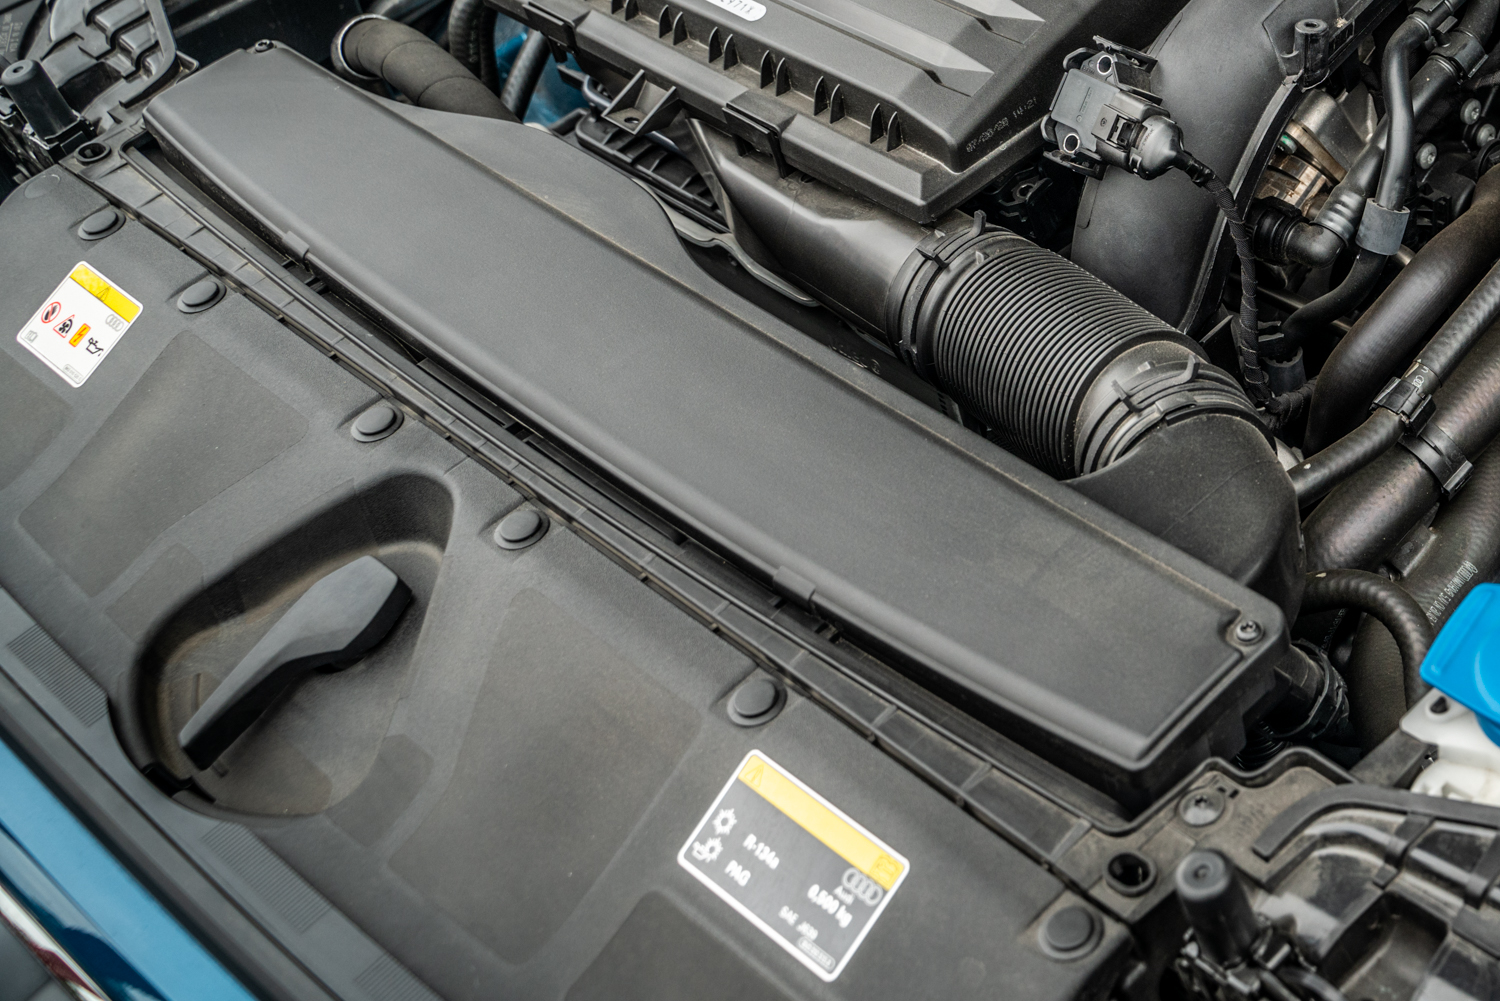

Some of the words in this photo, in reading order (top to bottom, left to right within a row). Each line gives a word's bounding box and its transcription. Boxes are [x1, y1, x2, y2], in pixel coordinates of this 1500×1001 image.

[724, 859, 751, 887] PAG
[778, 905, 799, 927] SAE
[742, 833, 780, 870] R-134a
[835, 905, 853, 929] kg
[833, 885, 856, 906] Audi
